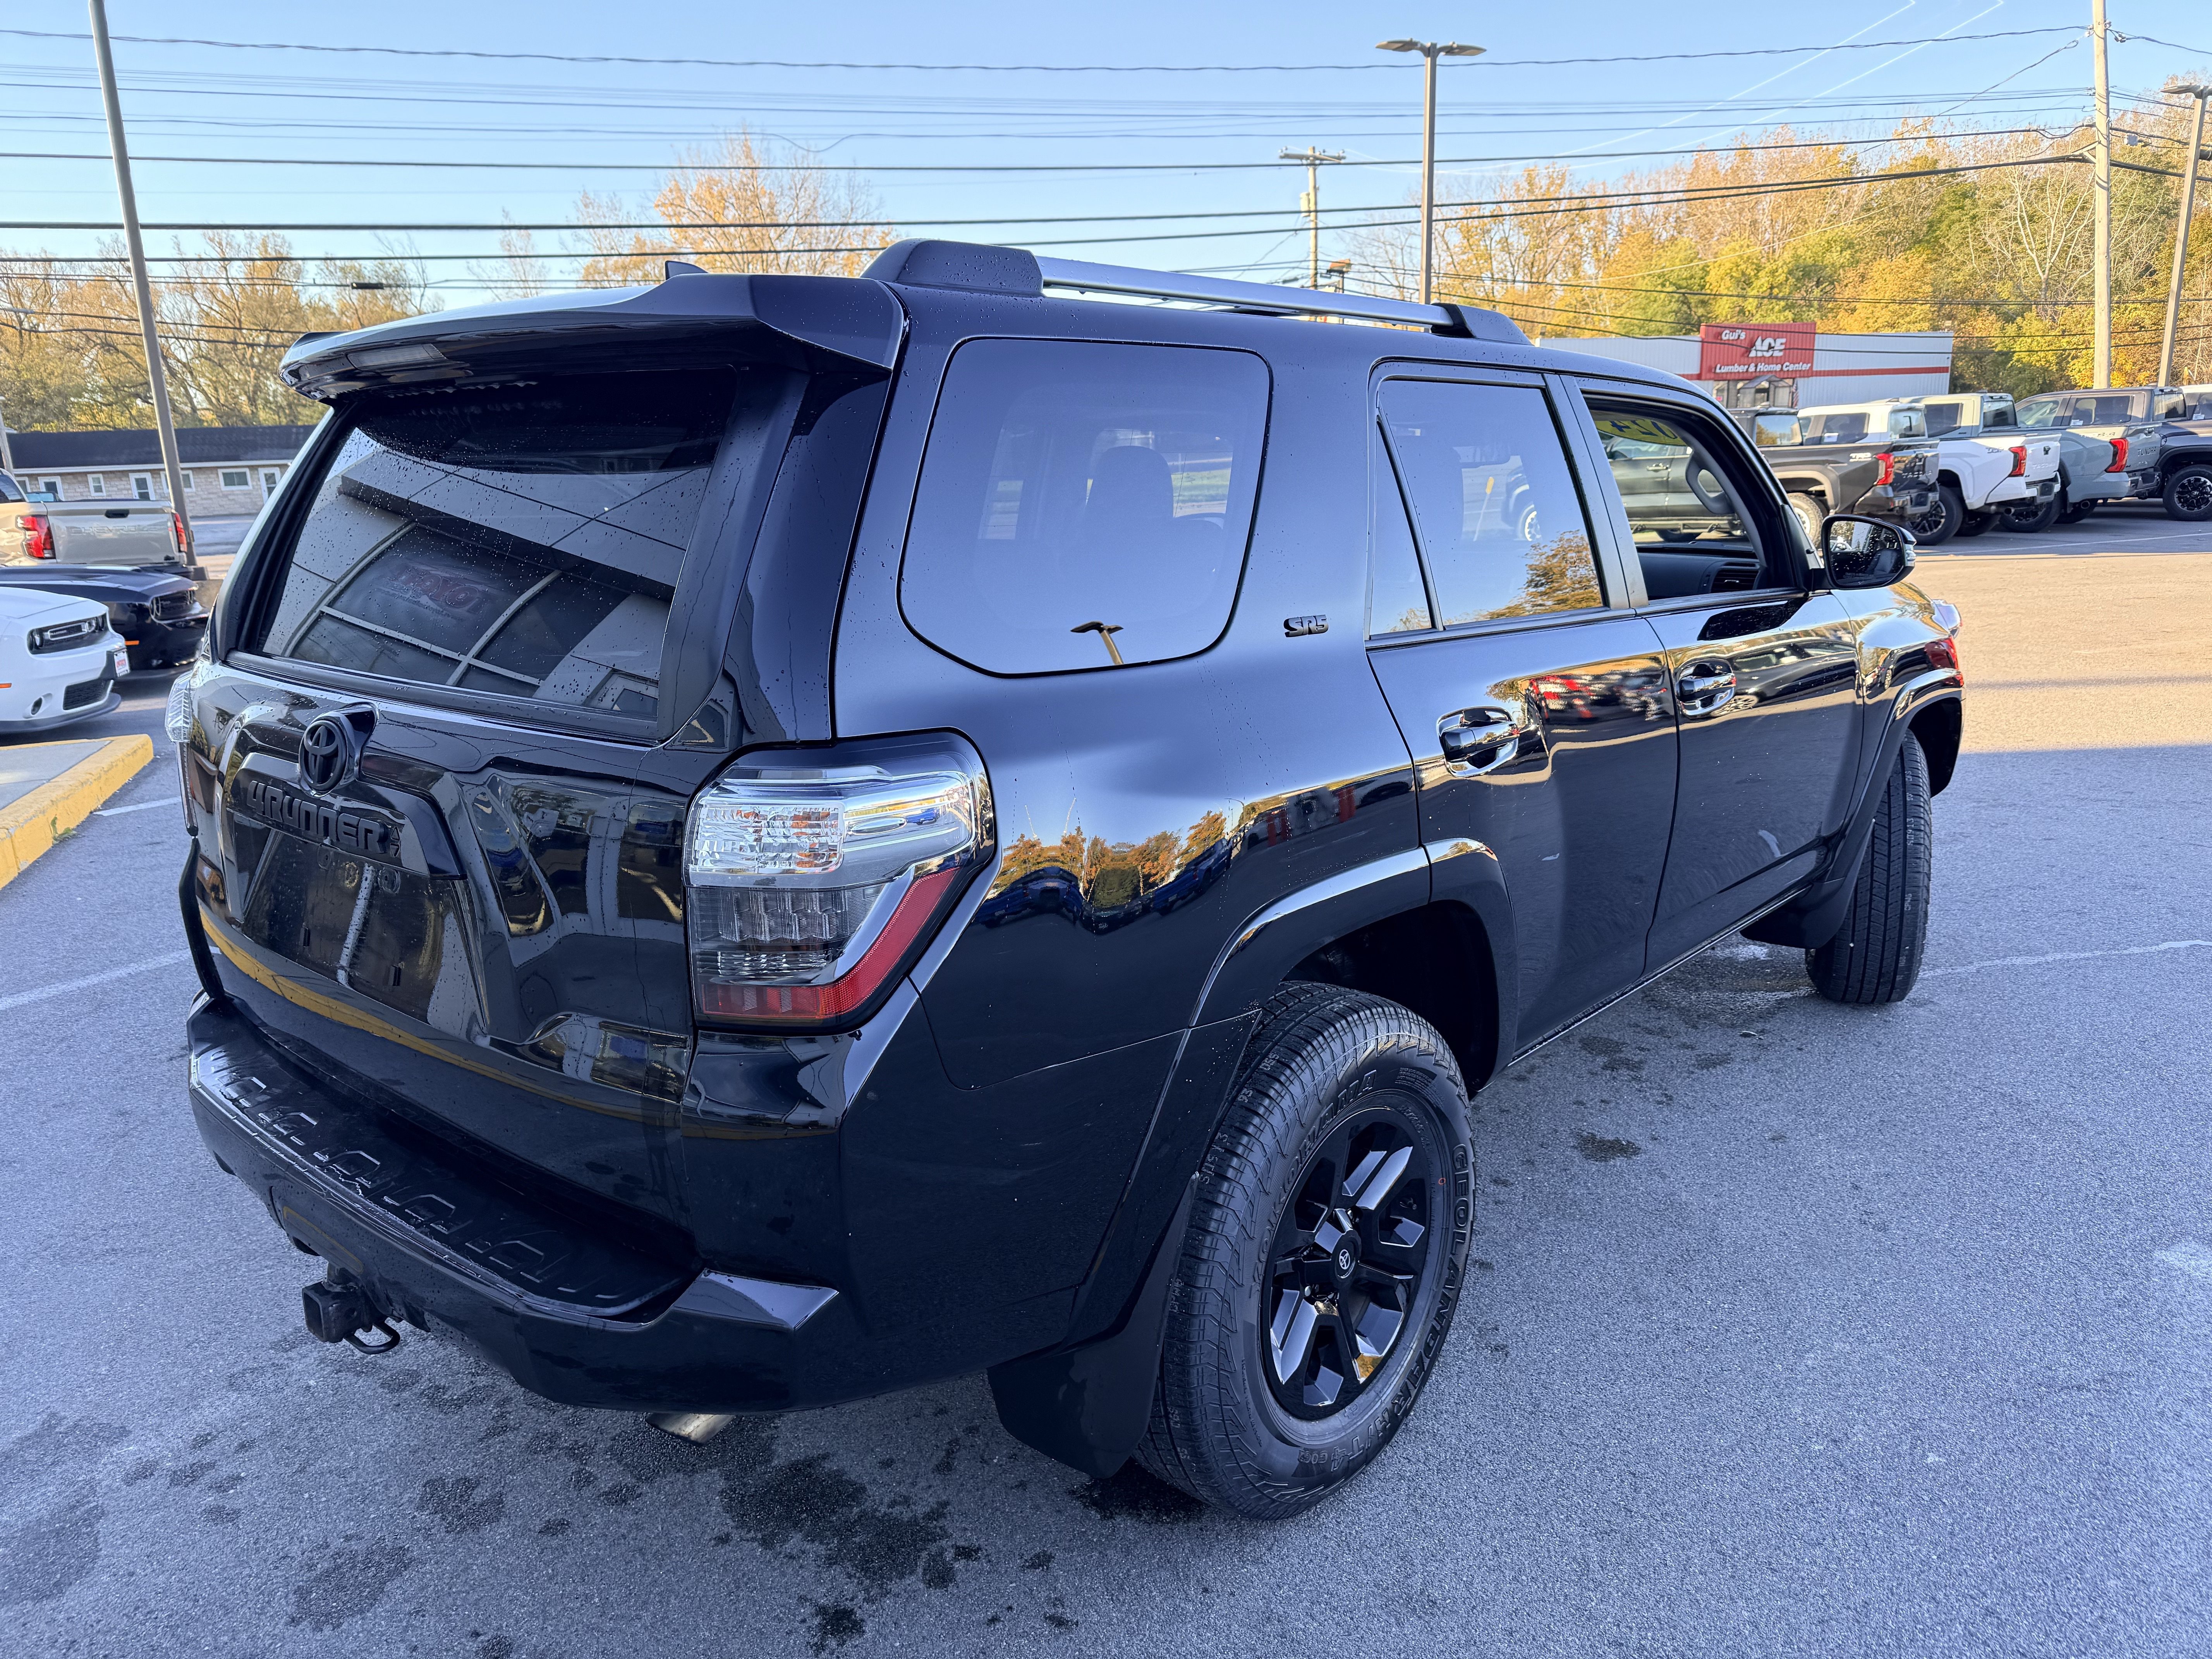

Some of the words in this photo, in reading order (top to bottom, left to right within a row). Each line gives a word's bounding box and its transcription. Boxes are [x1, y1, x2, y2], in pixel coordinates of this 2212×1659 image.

[1721, 330, 1746, 340] Gui's
[1748, 336, 1786, 357] ACE
[1715, 364, 1748, 373] Lumber
[1748, 363, 1756, 372] &
[1757, 363, 1782, 372] Home
[1783, 362, 1811, 371] Center
[1283, 614, 1329, 637] SR5
[247, 780, 387, 854] 4RUNNER
[1394, 1144, 1470, 1416] GEOLANDAR
